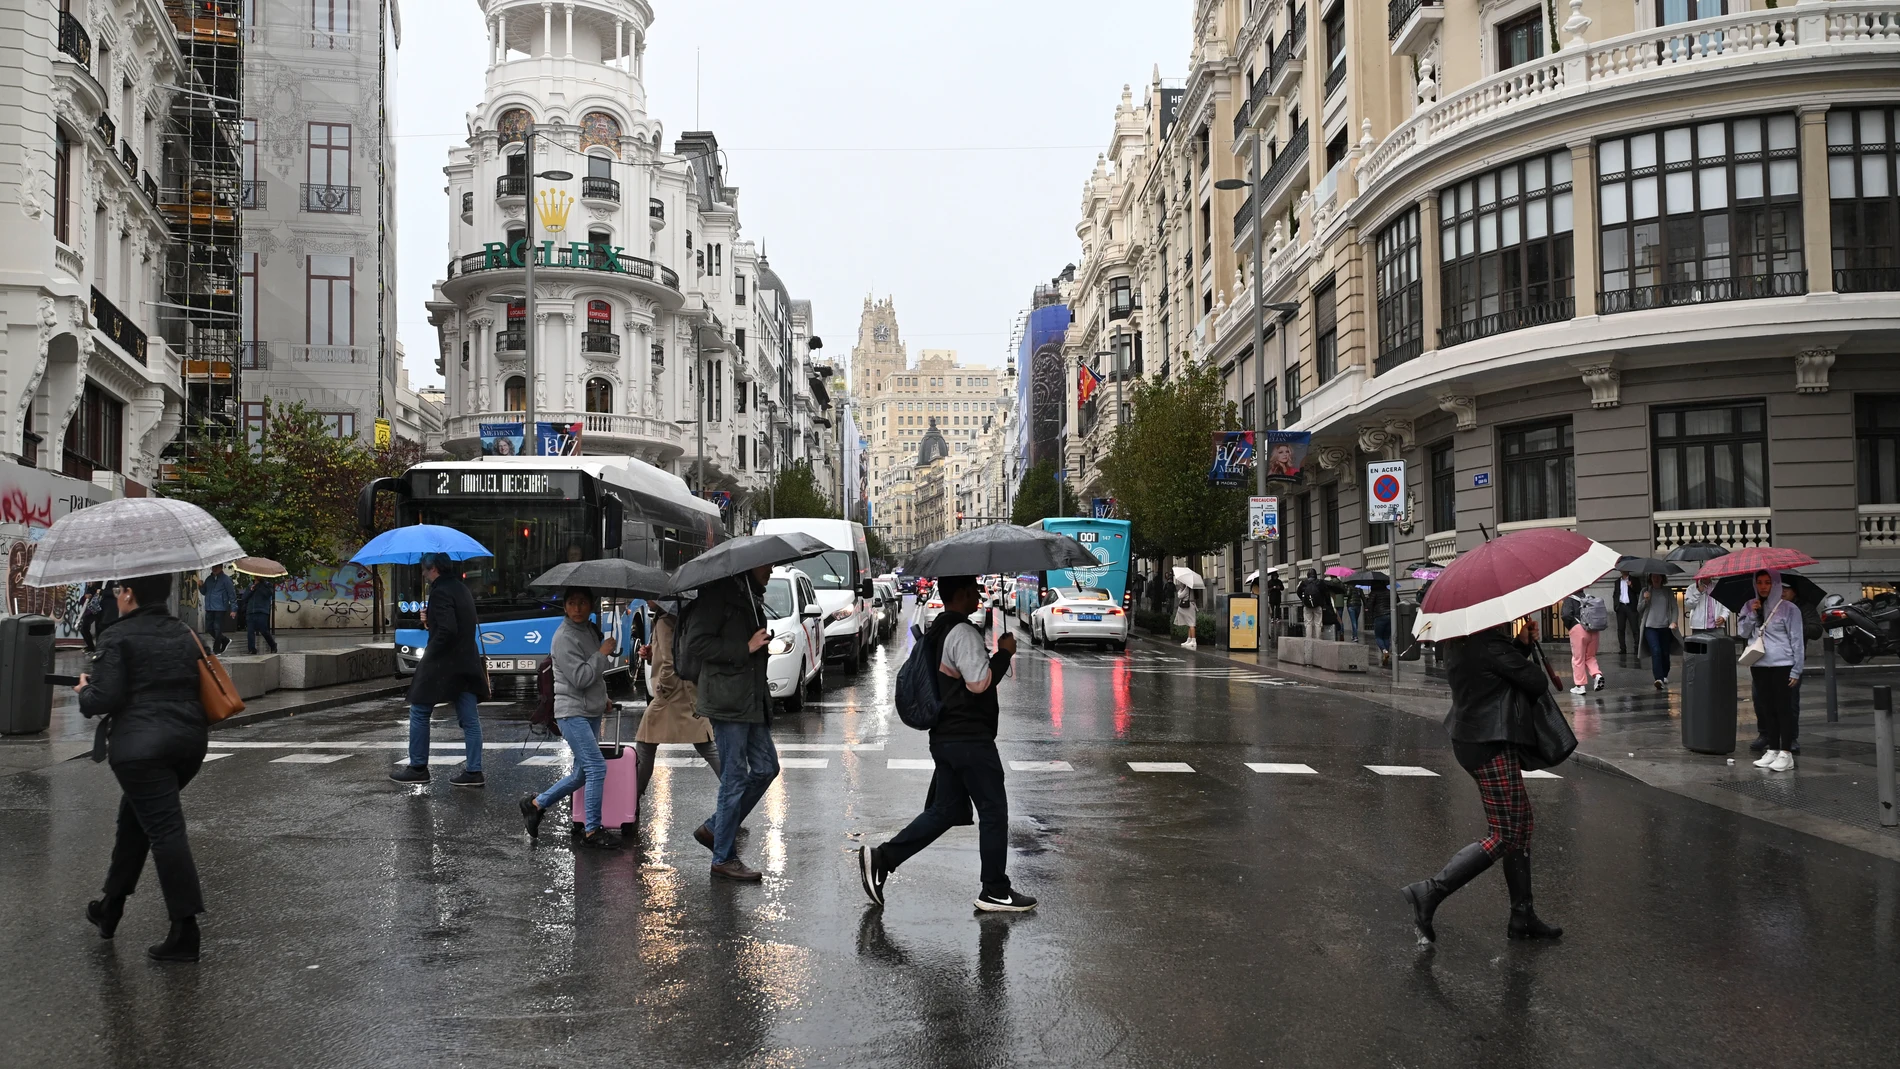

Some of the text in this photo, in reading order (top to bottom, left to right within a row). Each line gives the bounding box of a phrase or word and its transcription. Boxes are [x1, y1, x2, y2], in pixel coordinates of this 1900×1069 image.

[482, 239, 627, 273] ROLEX
[437, 472, 449, 494] 2
[1080, 532, 1095, 542] 001
[520, 660, 533, 668] SP
